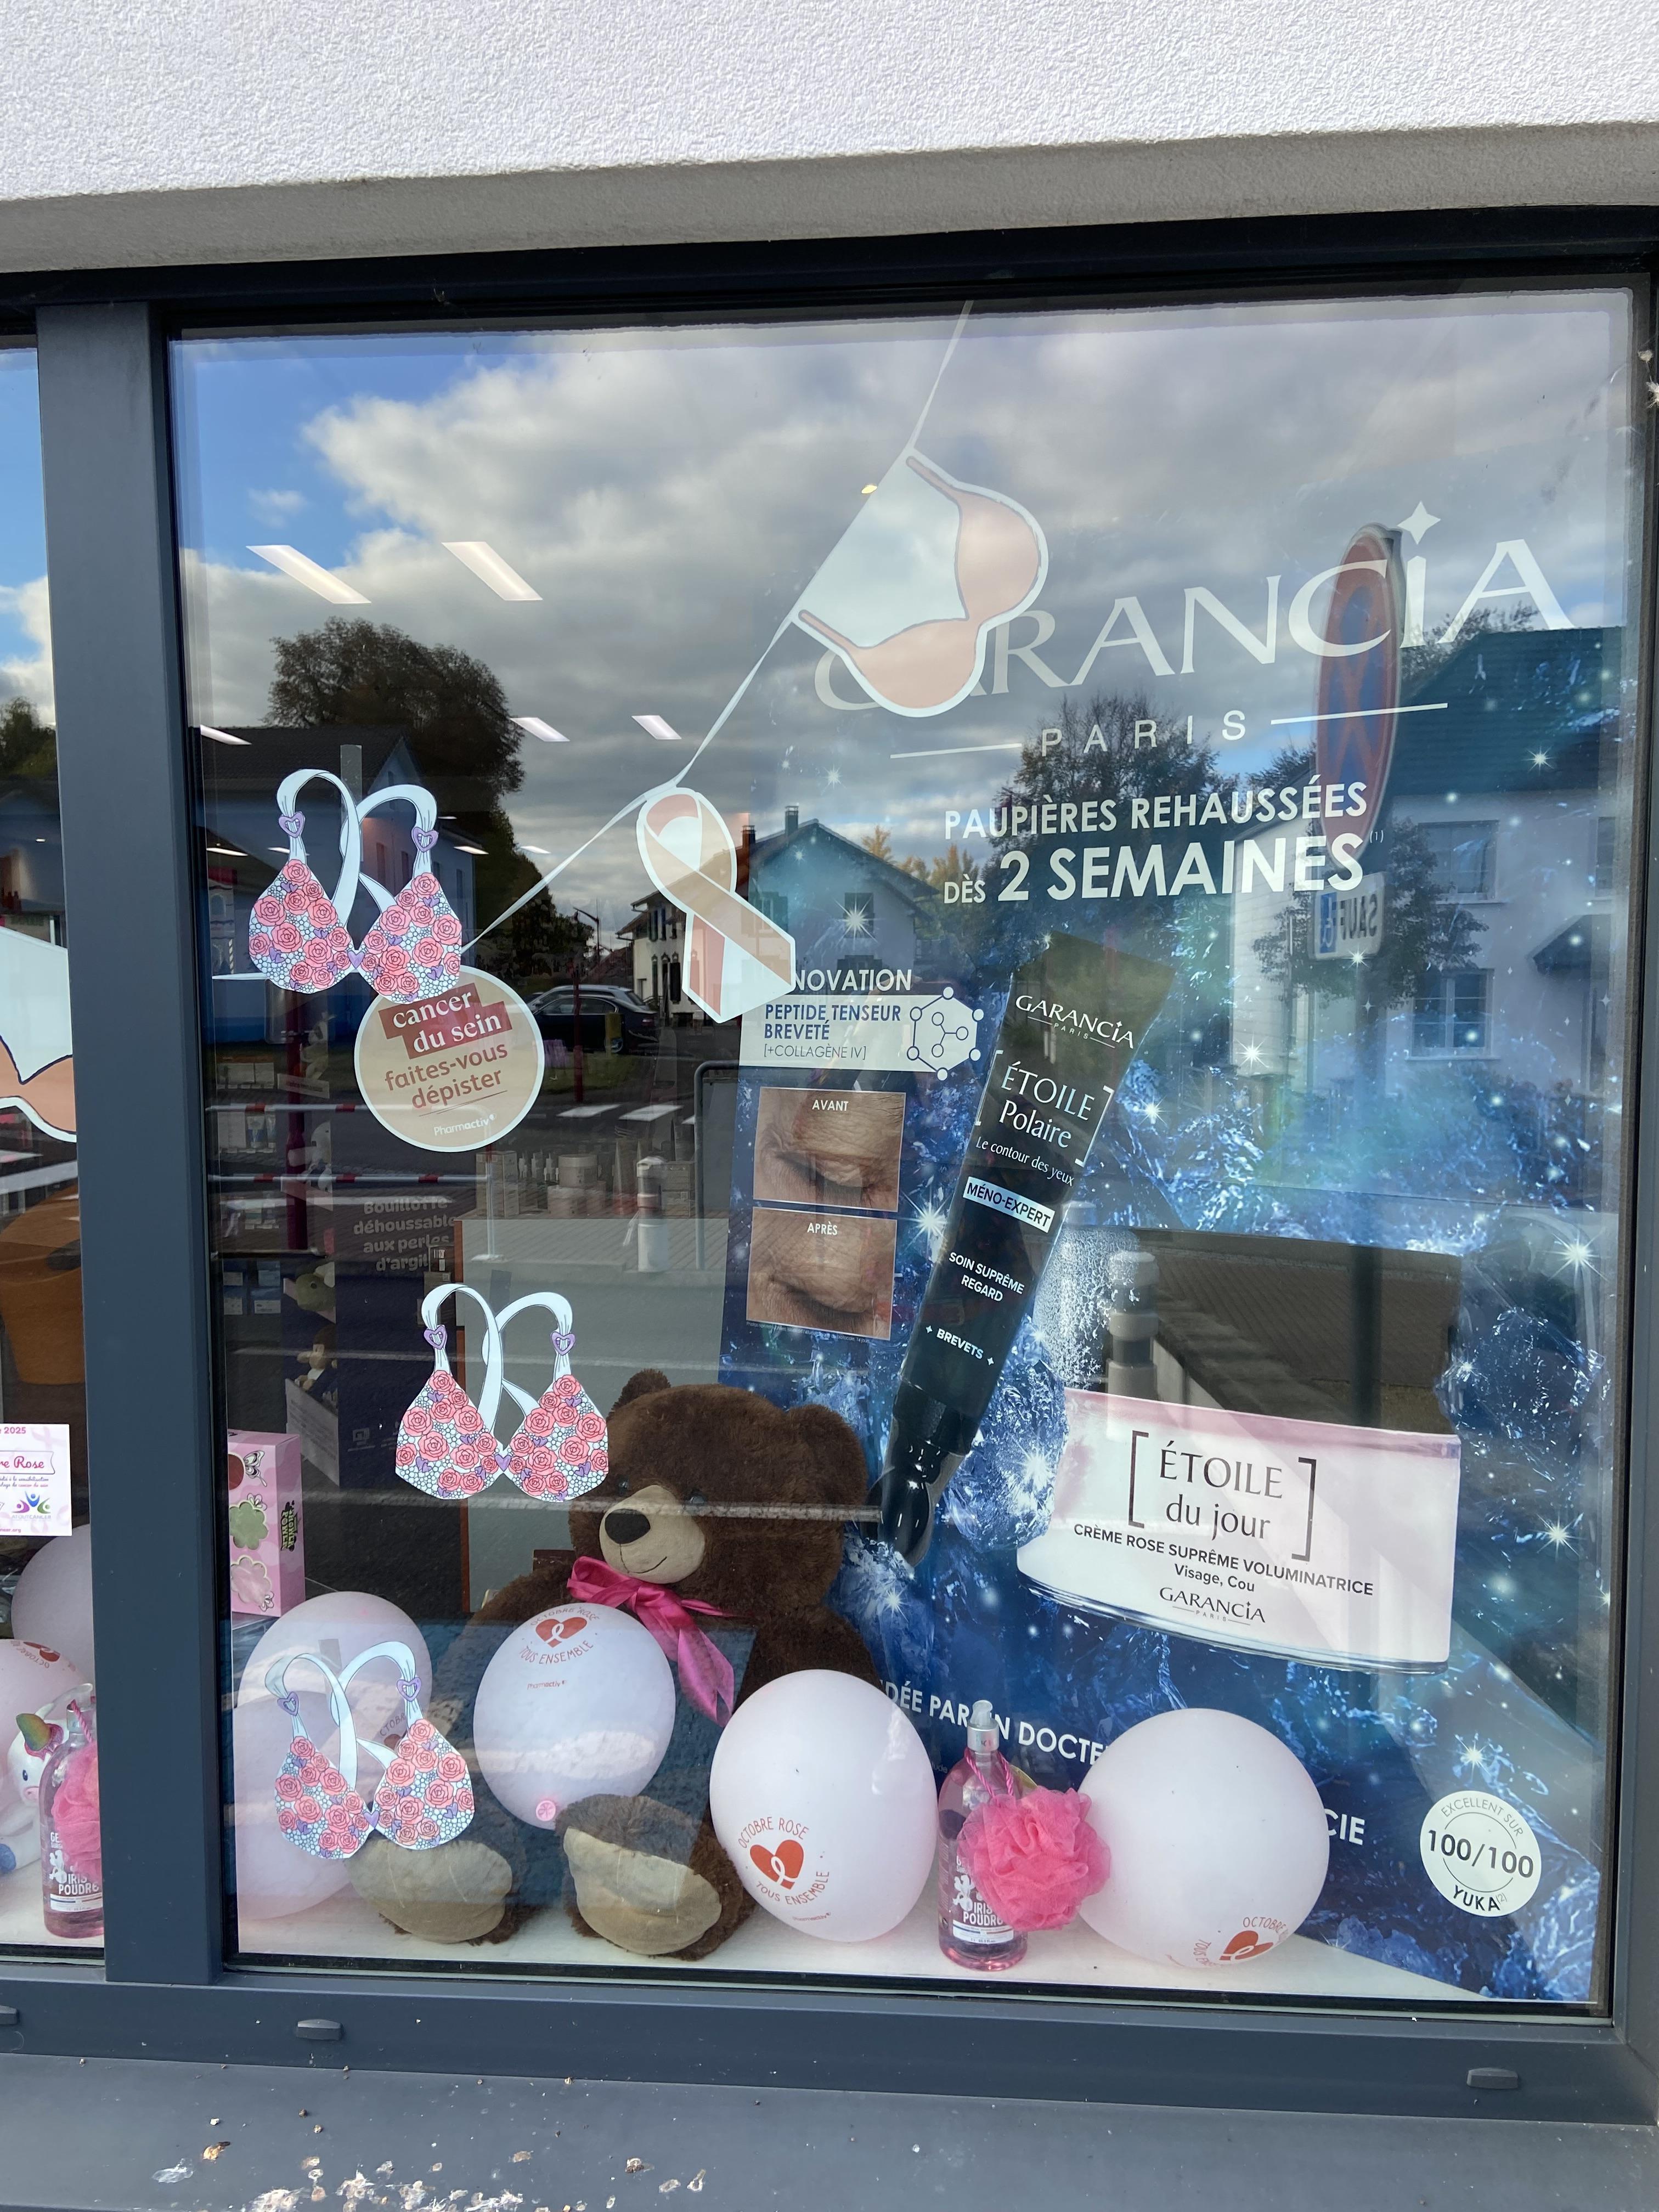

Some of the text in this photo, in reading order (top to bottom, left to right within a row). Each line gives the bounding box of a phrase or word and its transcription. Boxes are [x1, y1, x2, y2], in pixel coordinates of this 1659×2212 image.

[1041, 710, 1246, 757] PARIS
[945, 774, 1367, 840] PAUPIÈRES REHAUSSÉES
[944, 873, 986, 904] DÈS
[998, 851, 1030, 901] 2
[1047, 833, 1364, 901] SEMAINES
[795, 969, 912, 991] NOVATION
[393, 991, 473, 1028] cancer
[765, 1004, 901, 1021] PEPTIDE TENSEUR
[413, 1014, 502, 1053] du sein
[764, 1020, 830, 1040] BREVETÉ
[1054, 1022, 1088, 1040] PARIS
[385, 1043, 508, 1091] faites-vous
[412, 1070, 501, 1109] dépister
[812, 1100, 849, 1111] AVANT
[1001, 1061, 1095, 1120] ÉTOILE
[433, 1118, 489, 1136] Pharmactiv
[999, 1100, 1071, 1148] Polaire
[975, 1136, 1075, 1187] Le contour des yeux
[967, 1182, 1051, 1227] MÉNO-EXPERT
[353, 1215, 456, 1234] déhoussable
[807, 1221, 838, 1235] APRÈS
[363, 1240, 394, 1253] aux
[376, 1254, 428, 1271] d'argil
[949, 1252, 1025, 1295] SOIN SUPRÊME
[961, 1275, 1003, 1302] REGARD
[936, 1328, 984, 1359] BREVETS
[14, 1455, 44, 1469] Rose
[1159, 1440, 1283, 1499] ÉTOILE
[1166, 1494, 1270, 1541] du jour
[1074, 1523, 1374, 1595] CRÈME ROSE SUPRÊME VOLUMINATRICE
[1174, 1563, 1255, 1592] Visage, Cou
[1196, 1610, 1227, 1622] PARIS
[539, 1640, 594, 1664] ENSEMBLE
[380, 1712, 406, 1736] CTOBR
[879, 1680, 1110, 1765] DÉE PAR N DOCTE
[738, 1816, 809, 1848] OCTOBRE ROSE
[1325, 1808, 1365, 1846] CIE
[1441, 1797, 1523, 1837] EXCELLENT SUR
[50, 1832, 61, 1843] GE
[1428, 1829, 1534, 1878] 100/100
[755, 1871, 830, 1905] TOUS ENSEMBLE
[1453, 1884, 1500, 1911] YUKA
[1243, 1917, 1286, 1933] OCTOBRE
